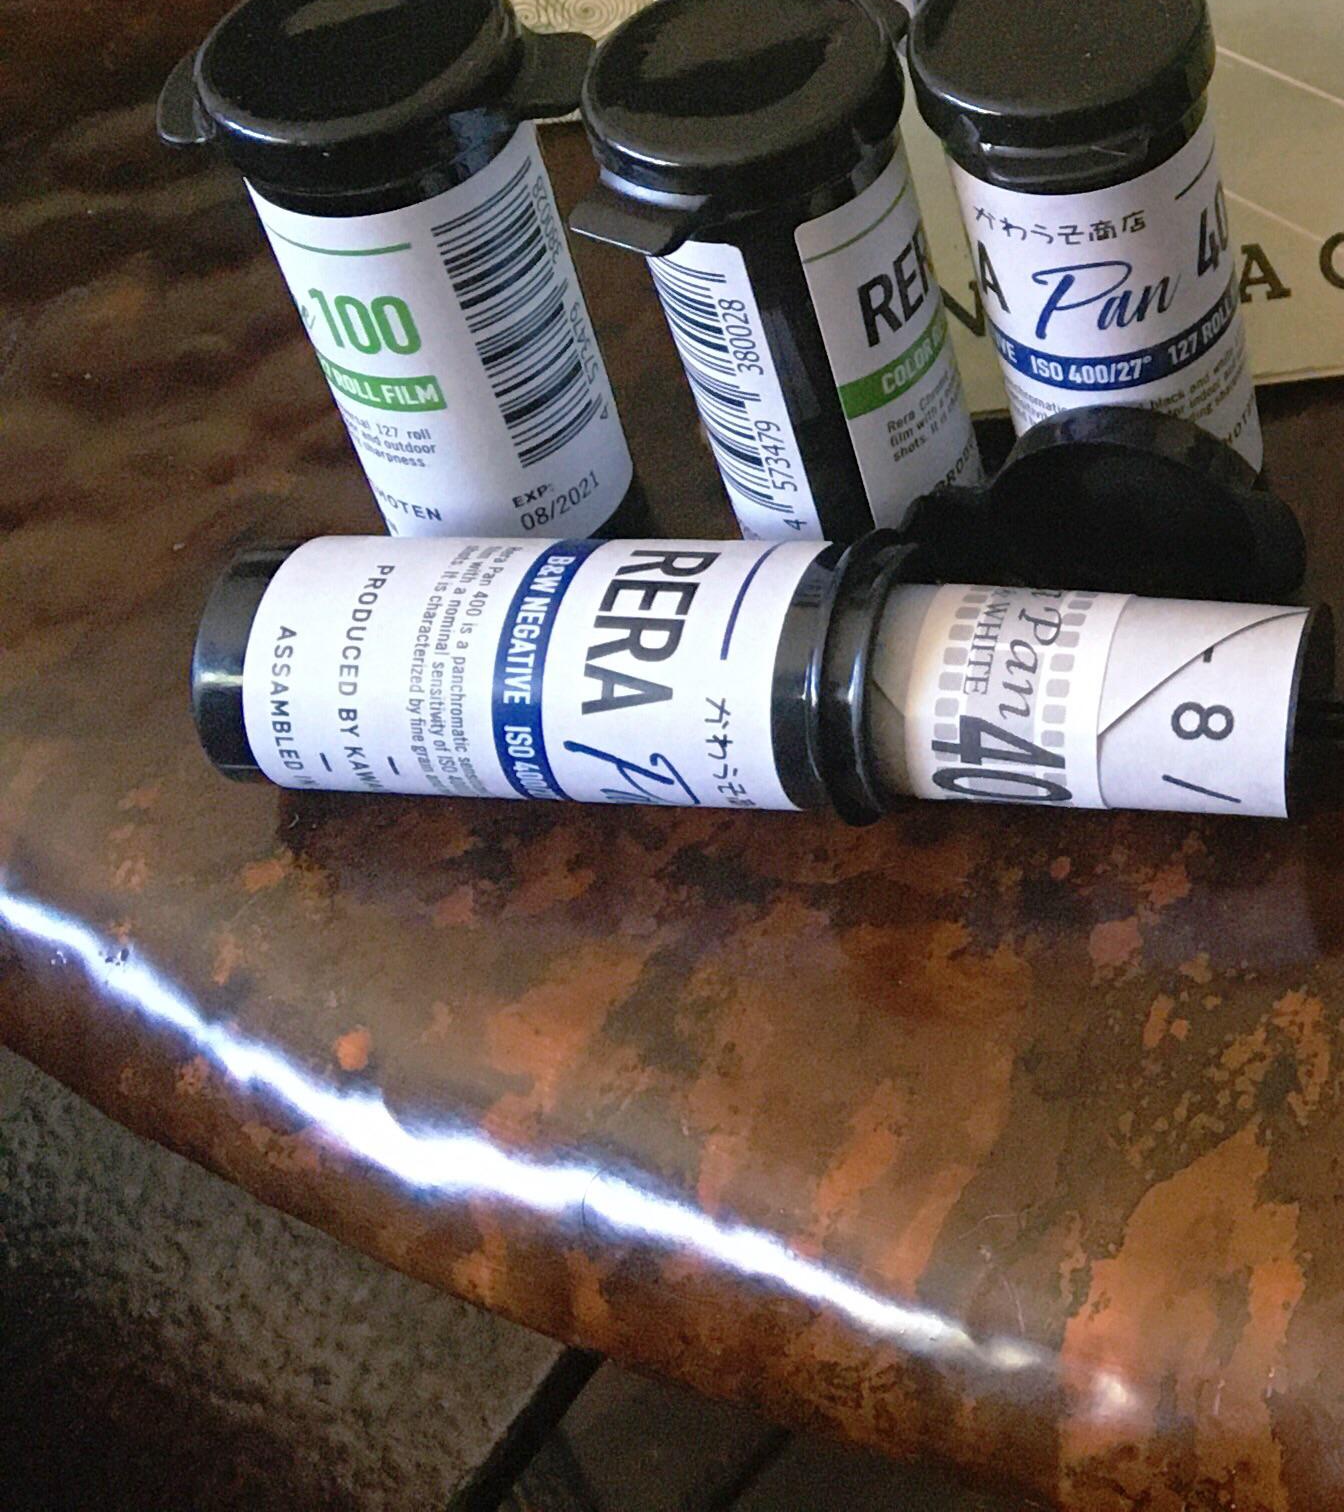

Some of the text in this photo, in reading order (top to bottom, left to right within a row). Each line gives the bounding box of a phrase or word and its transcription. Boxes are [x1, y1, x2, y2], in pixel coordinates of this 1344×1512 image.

[973, 206, 1148, 246] かわうそ商店
[1031, 260, 1182, 339] Pan
[308, 288, 422, 355] 100
[1030, 354, 1064, 382] ISO
[1168, 329, 1199, 365] 127
[380, 384, 440, 405] FILM
[376, 423, 399, 439] 127
[406, 428, 432, 440] roll
[719, 298, 808, 532] 4 573479 380028
[383, 438, 437, 454] outdoor
[521, 469, 602, 532] 08/2021
[434, 582, 454, 592] is
[453, 587, 467, 595] a
[479, 566, 504, 587] Pan
[530, 554, 577, 594] B&W
[466, 590, 489, 617] 400
[337, 565, 395, 696] PRODUCED
[410, 595, 443, 694] characterized
[434, 599, 461, 656] nominal
[456, 640, 469, 650] a
[460, 622, 478, 635] is
[582, 550, 722, 716] RERA
[962, 599, 1009, 696] WHITE
[503, 596, 552, 706] NEGATIVE
[999, 606, 1063, 720] Pan
[270, 625, 304, 771] ASSAMBLED
[406, 698, 425, 715] by
[428, 661, 445, 739] sensitivity
[450, 655, 470, 754] panchromatic
[338, 707, 360, 738] BY
[410, 718, 427, 743] fine
[1171, 701, 1235, 741] 8
[433, 739, 452, 753] of
[503, 724, 537, 759] ISO
[931, 714, 1073, 803] 40
[437, 755, 458, 774] ISO
